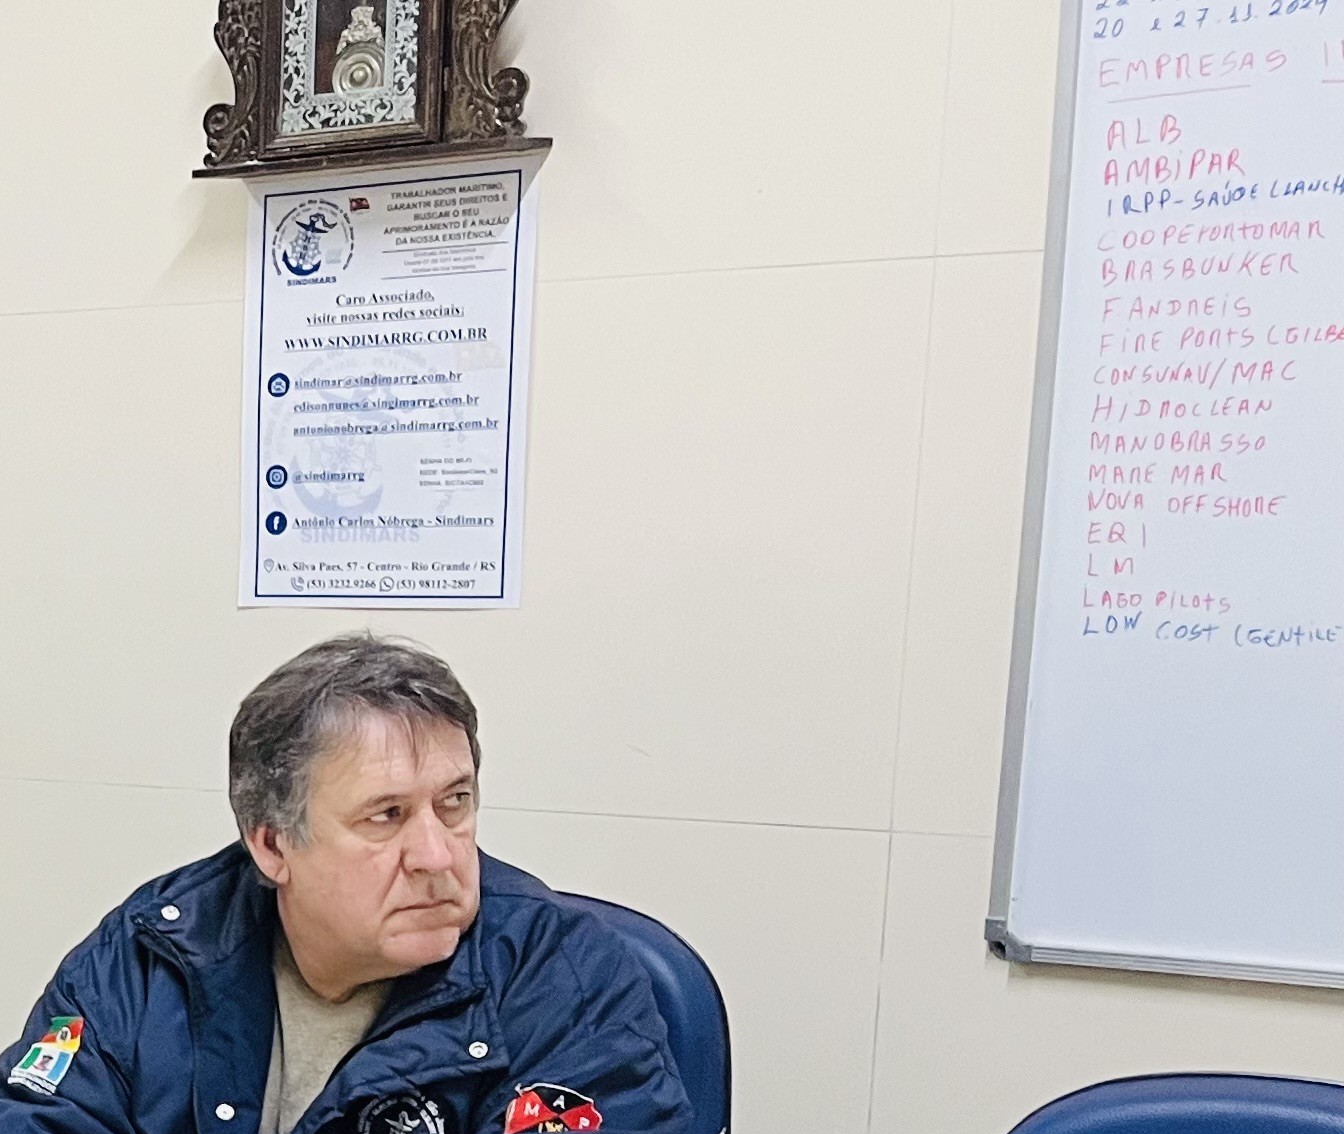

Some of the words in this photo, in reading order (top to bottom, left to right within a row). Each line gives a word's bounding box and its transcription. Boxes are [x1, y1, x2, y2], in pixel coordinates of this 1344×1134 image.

[1093, 17, 1124, 39] 20
[1100, 49, 1287, 87] EMPRESAS
[1107, 114, 1182, 150] ALB
[387, 200, 431, 212] GARANTIR
[434, 197, 457, 209] SEUS
[459, 193, 500, 206] DIREITOS
[502, 193, 509, 202] E
[391, 186, 457, 200] TRABALHADOR
[413, 210, 451, 222] BUSCAR
[452, 209, 460, 218] O
[462, 207, 480, 217] SEU
[384, 221, 461, 235] APRIMORAMENTO
[470, 218, 477, 227] A
[395, 237, 408, 246] DA
[410, 234, 441, 245] NOSSA
[1102, 250, 1299, 287] BRASBUNKER
[287, 276, 337, 287] SINDIMARS
[336, 293, 366, 307] Caro
[368, 289, 435, 305] Associado,
[307, 312, 337, 326] visite
[341, 309, 379, 322] nossas
[383, 307, 416, 320] redes
[284, 326, 488, 351] WWW.SINDIMARRG.COM.BR
[293, 469, 365, 483] @sindimarrg
[1170, 462, 1227, 485] MAR
[1088, 487, 1145, 512] NOVA
[338, 516, 374, 527] Carlos
[435, 514, 494, 528] Sindimars
[292, 561, 316, 572] Silva
[346, 561, 358, 572] 57
[367, 561, 402, 572] Centro
[411, 561, 429, 572] Rio
[431, 560, 471, 572] Grande
[479, 560, 497, 572] RS
[1082, 611, 1142, 637] LOW
[1156, 620, 1220, 642] COST
